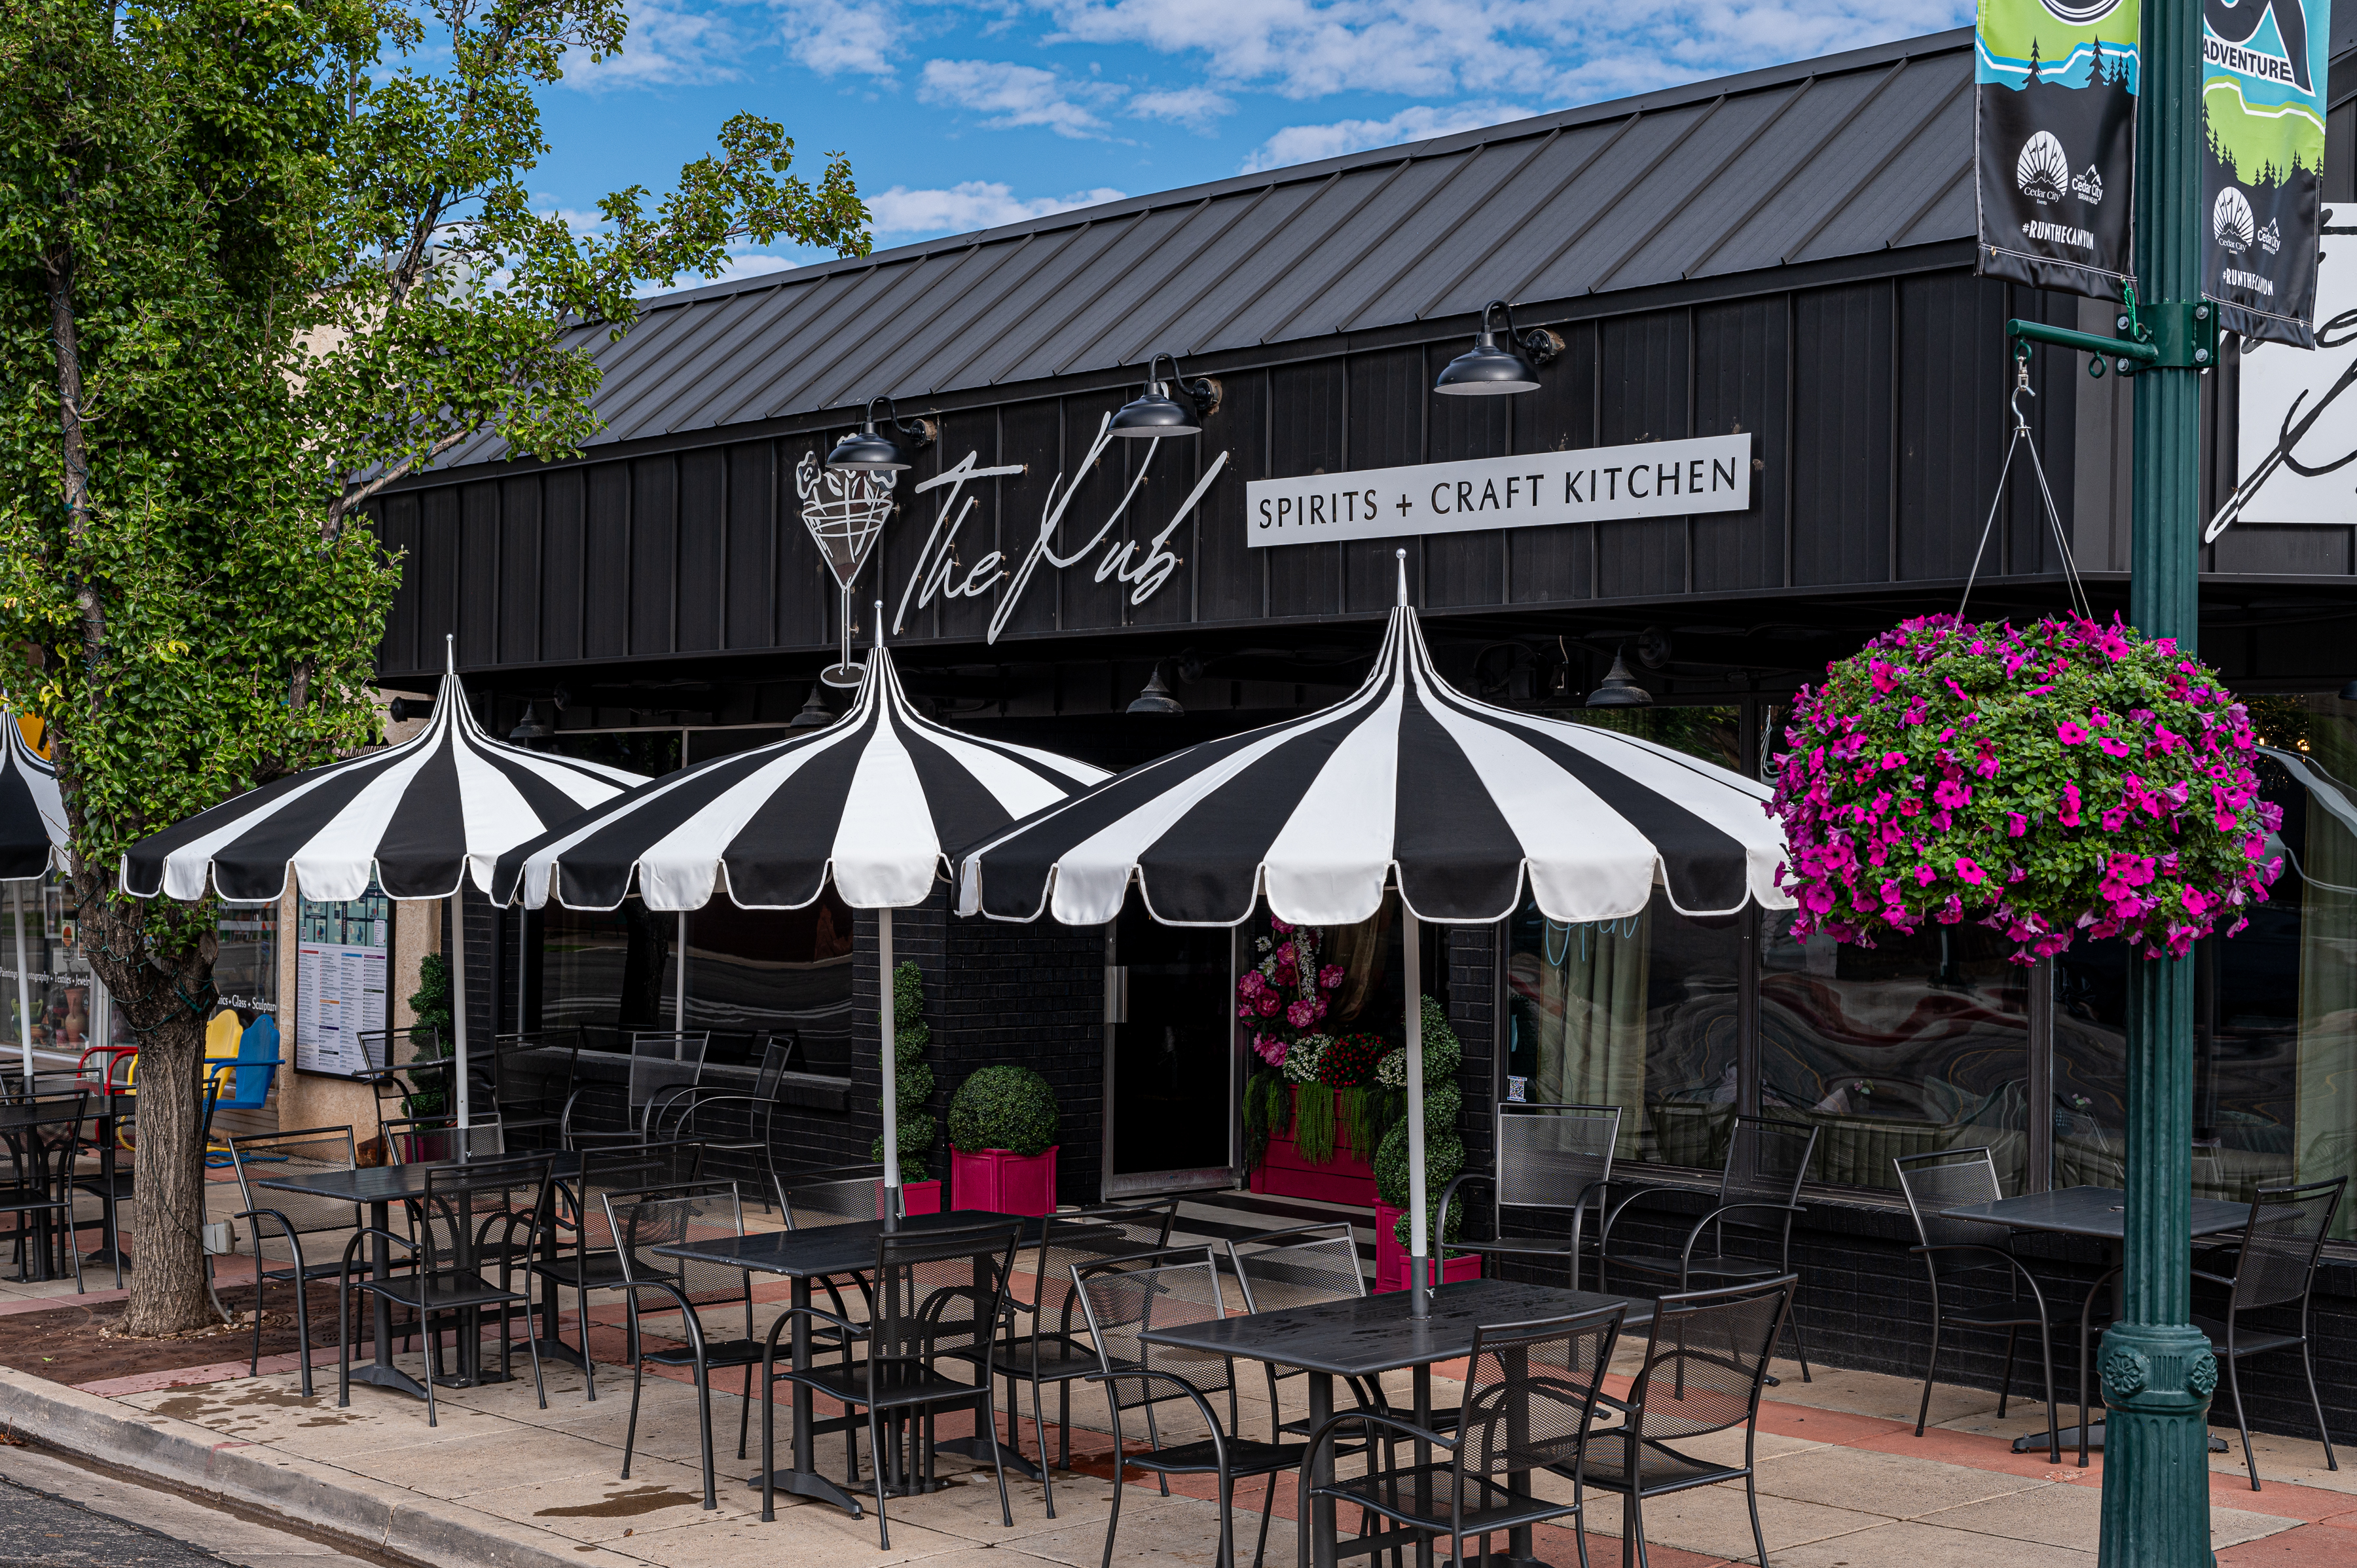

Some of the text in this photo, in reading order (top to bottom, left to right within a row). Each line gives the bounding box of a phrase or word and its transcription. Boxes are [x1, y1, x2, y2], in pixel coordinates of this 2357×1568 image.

[2204, 39, 2293, 83] ADVENTURE
[2024, 187, 2060, 202] Cedar City
[2072, 178, 2103, 201] Cedar City
[2077, 192, 2098, 205] BRIAN HEAD
[2022, 220, 2094, 250] #RUNTHECANYON
[2218, 238, 2246, 253] Cedar City
[1258, 489, 1378, 530] SPIRITS
[1431, 473, 1544, 515] CRAFT
[1565, 456, 1736, 505] KITCHEN
[893, 382, 1228, 645] The Pub
[27, 971, 49, 983] otography
[54, 972, 71, 984] Textiles
[232, 994, 247, 1008] Glass
